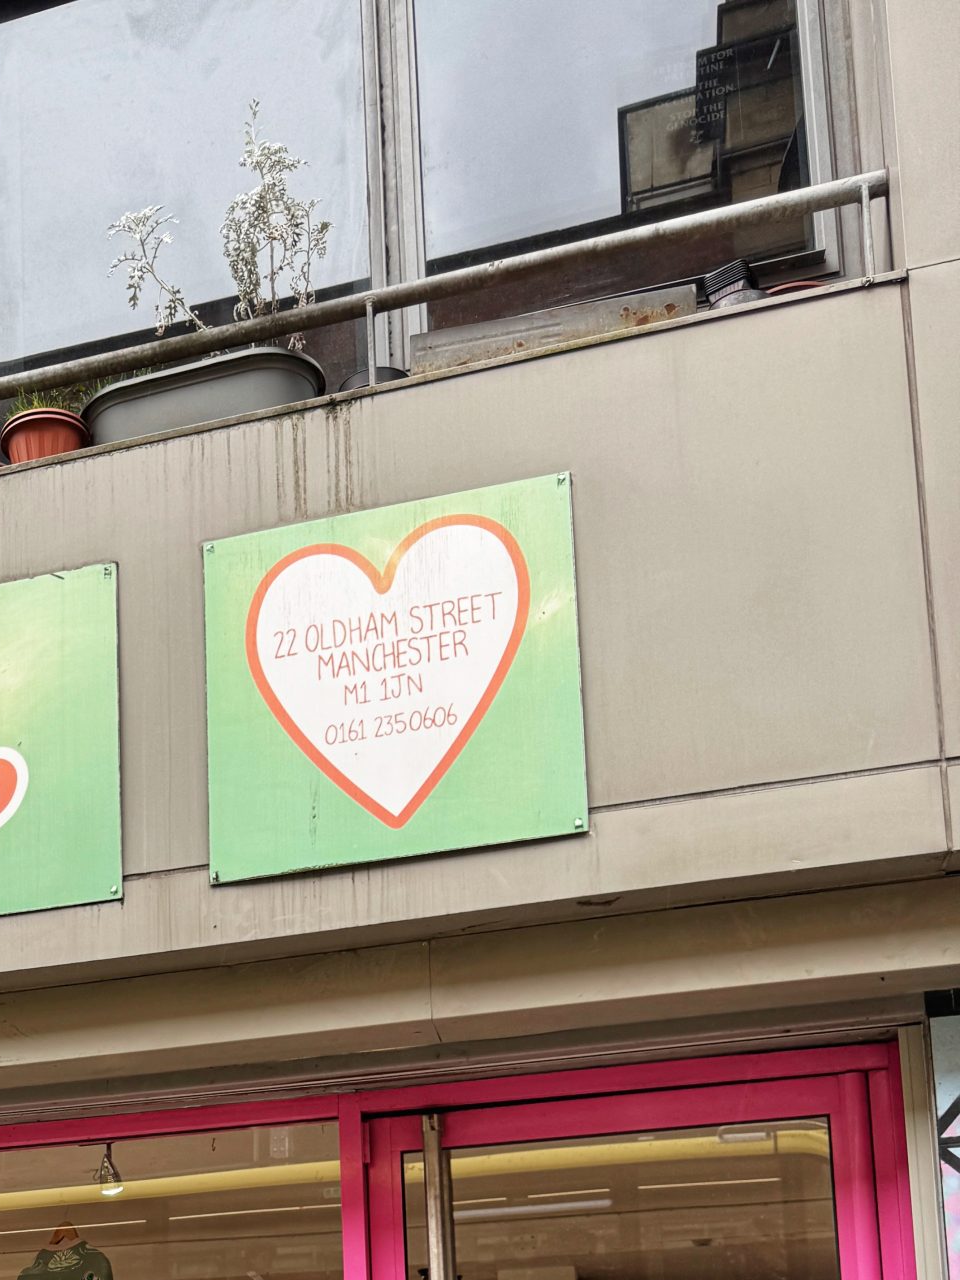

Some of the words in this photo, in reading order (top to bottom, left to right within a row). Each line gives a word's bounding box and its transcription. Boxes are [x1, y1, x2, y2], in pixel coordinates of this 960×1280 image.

[702, 101, 725, 114] THE
[274, 628, 298, 660] 22
[304, 610, 399, 653] OLDHAM
[408, 591, 503, 635] STREET
[317, 629, 469, 680] MANCHESTER
[343, 680, 371, 705] M1
[379, 672, 424, 702] 1JN
[324, 718, 368, 746] 0161
